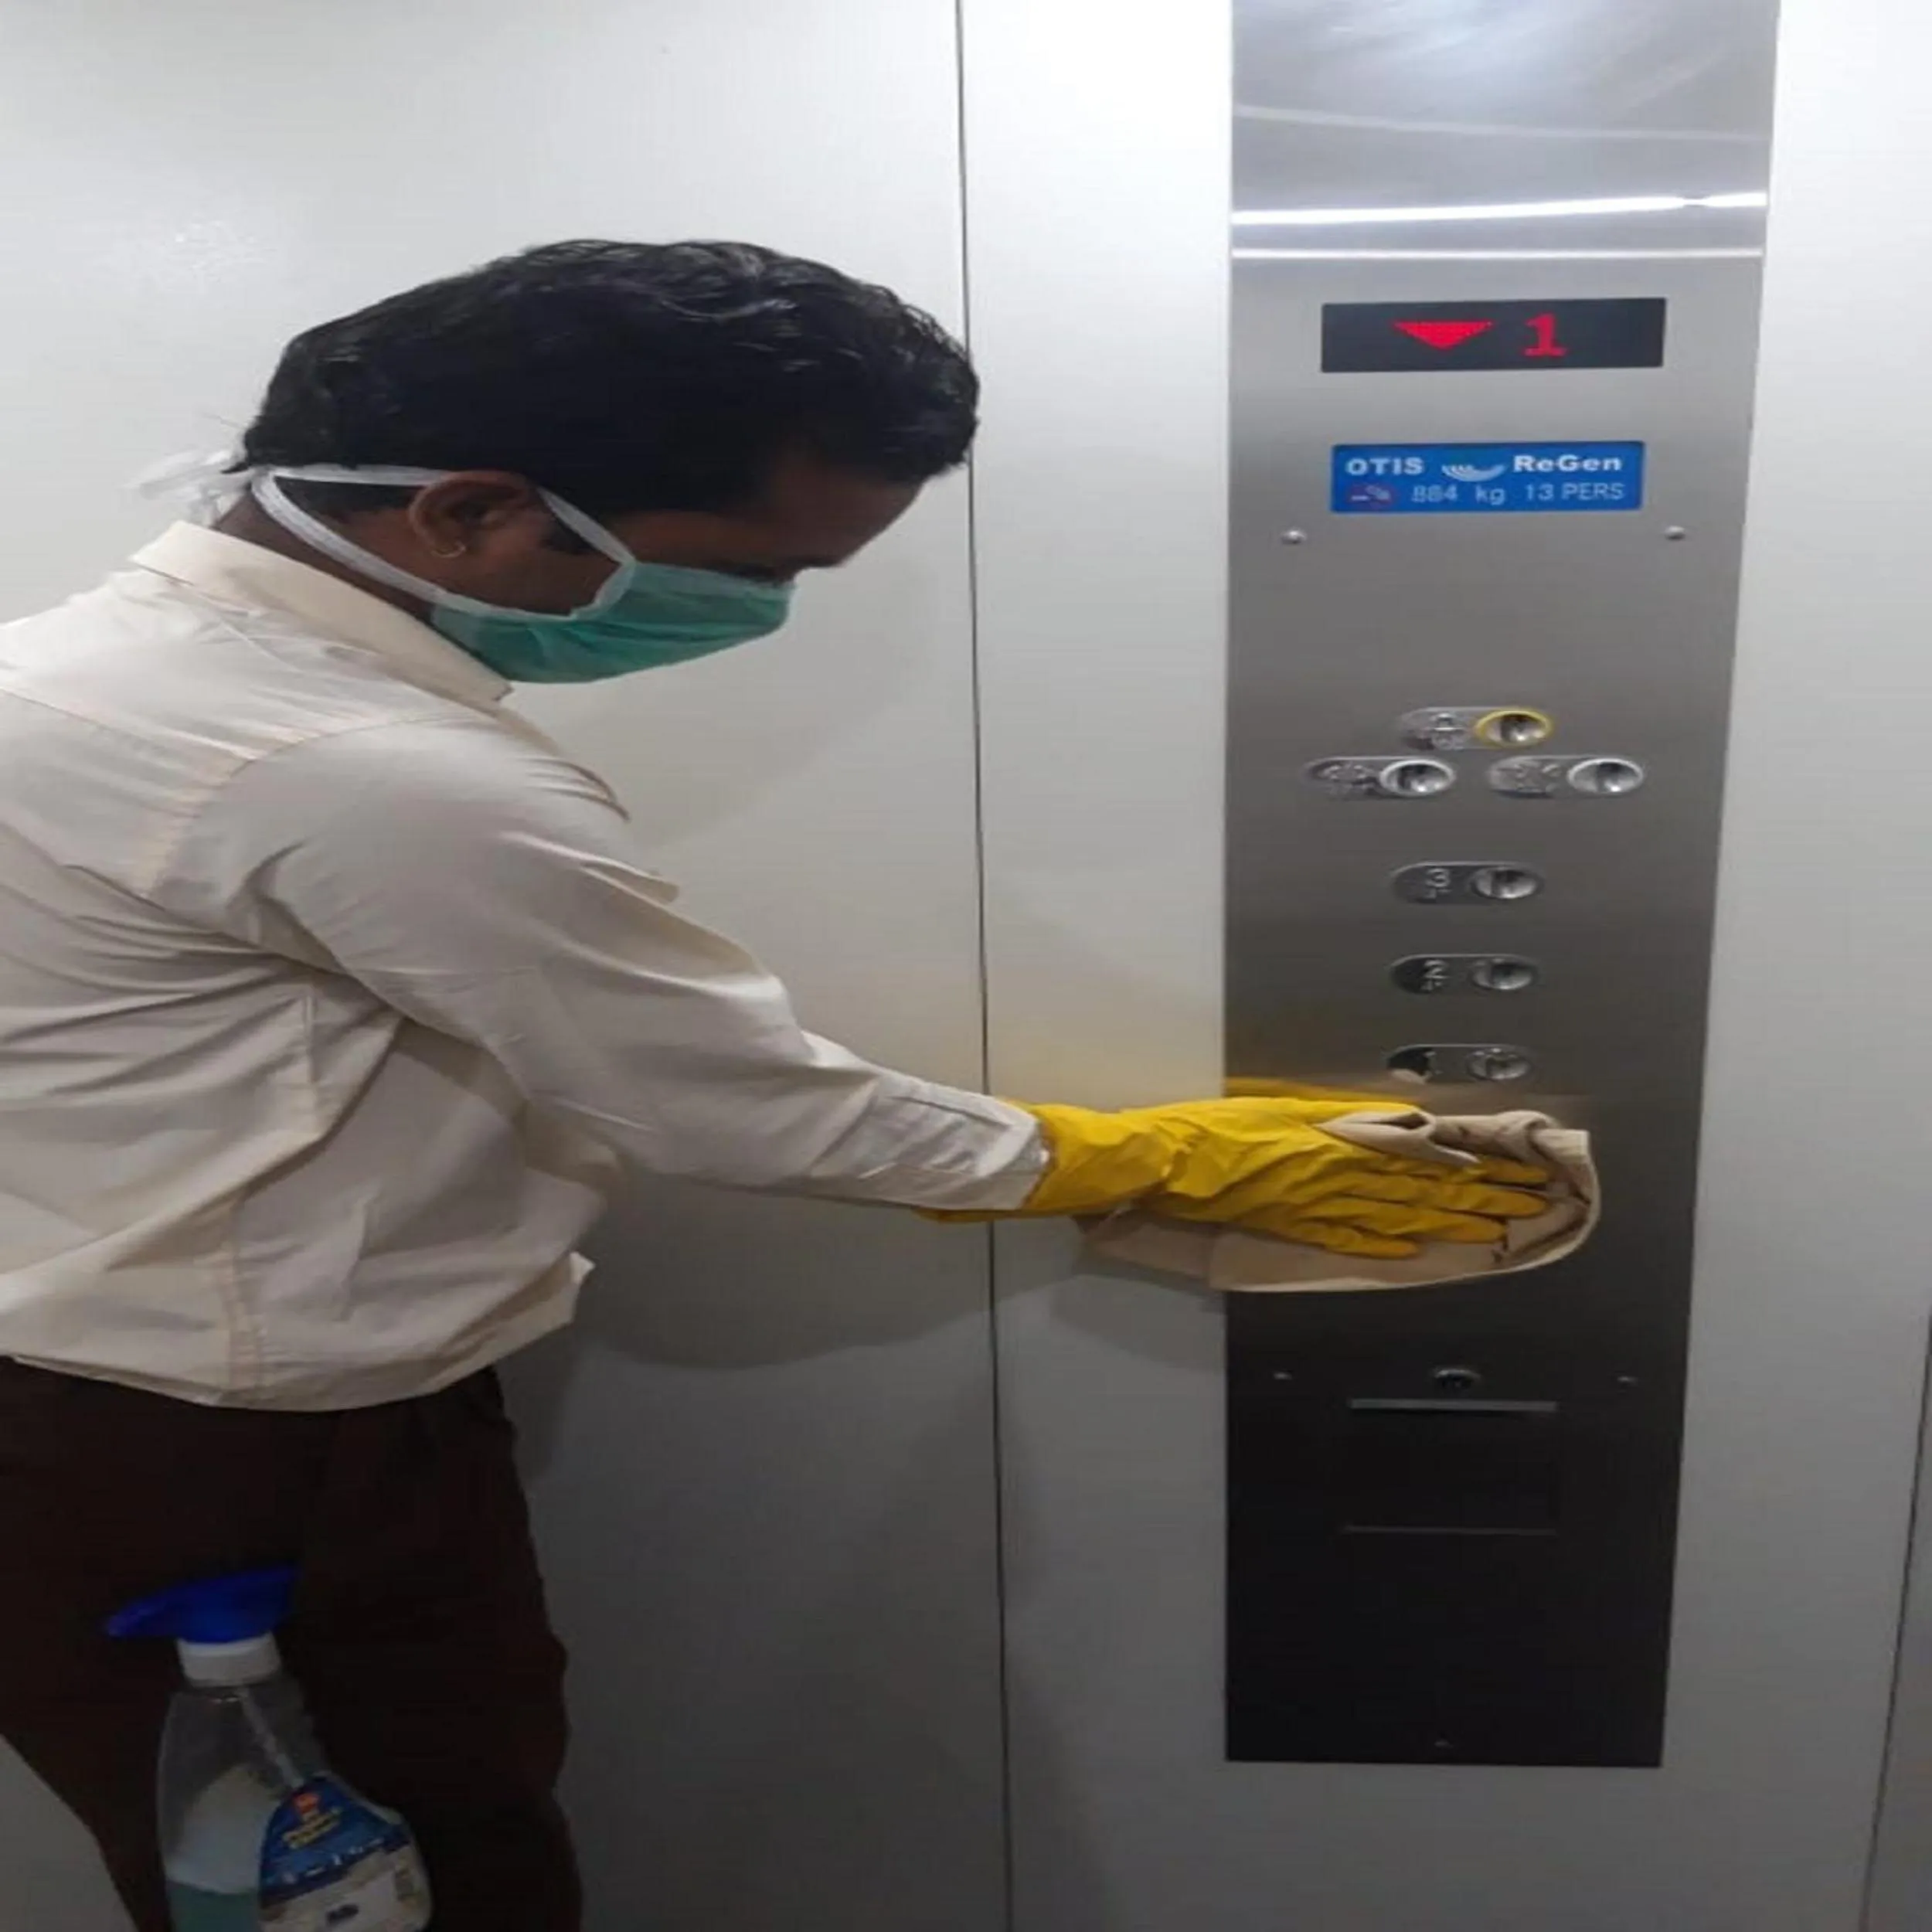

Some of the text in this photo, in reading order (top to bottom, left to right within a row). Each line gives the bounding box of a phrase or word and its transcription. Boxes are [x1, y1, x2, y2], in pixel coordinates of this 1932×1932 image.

[1524, 313, 1567, 358] 1
[1345, 454, 1622, 476] OTIS ReGen
[1475, 485, 1505, 505] kg
[1525, 484, 1554, 501] 13
[1561, 482, 1625, 500] PERS
[1424, 868, 1451, 889] 3
